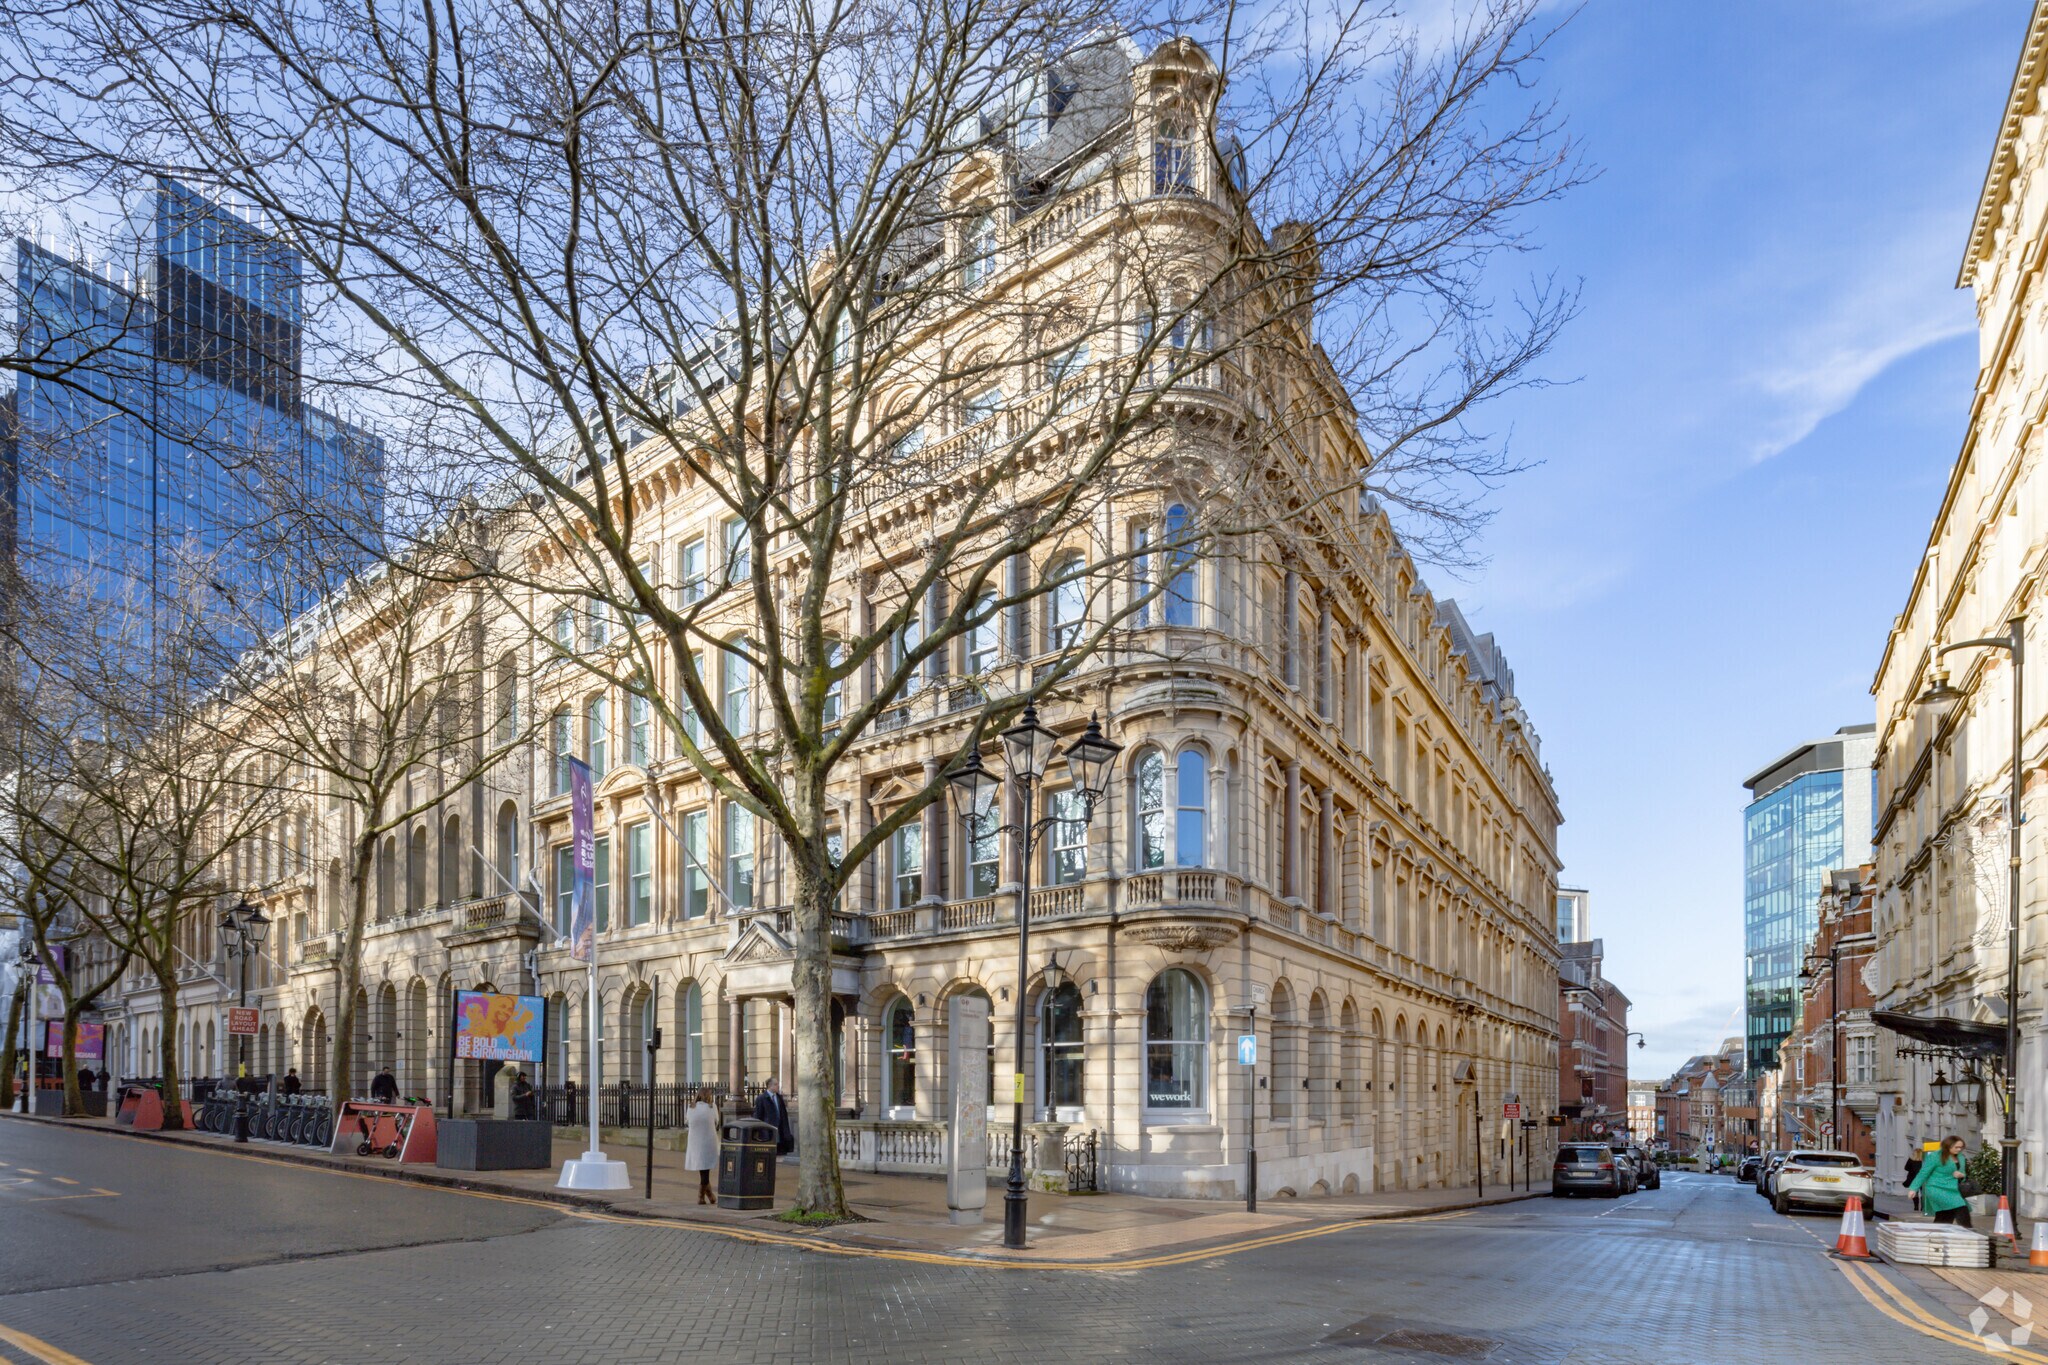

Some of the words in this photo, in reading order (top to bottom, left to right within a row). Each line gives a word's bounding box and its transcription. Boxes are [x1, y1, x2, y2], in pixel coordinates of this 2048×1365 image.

[458, 1036, 471, 1047] BE
[474, 1037, 498, 1048] BOLD
[458, 1046, 471, 1057] BE
[473, 1046, 533, 1061] BIRMINGHAM
[1150, 1091, 1192, 1101] wework
